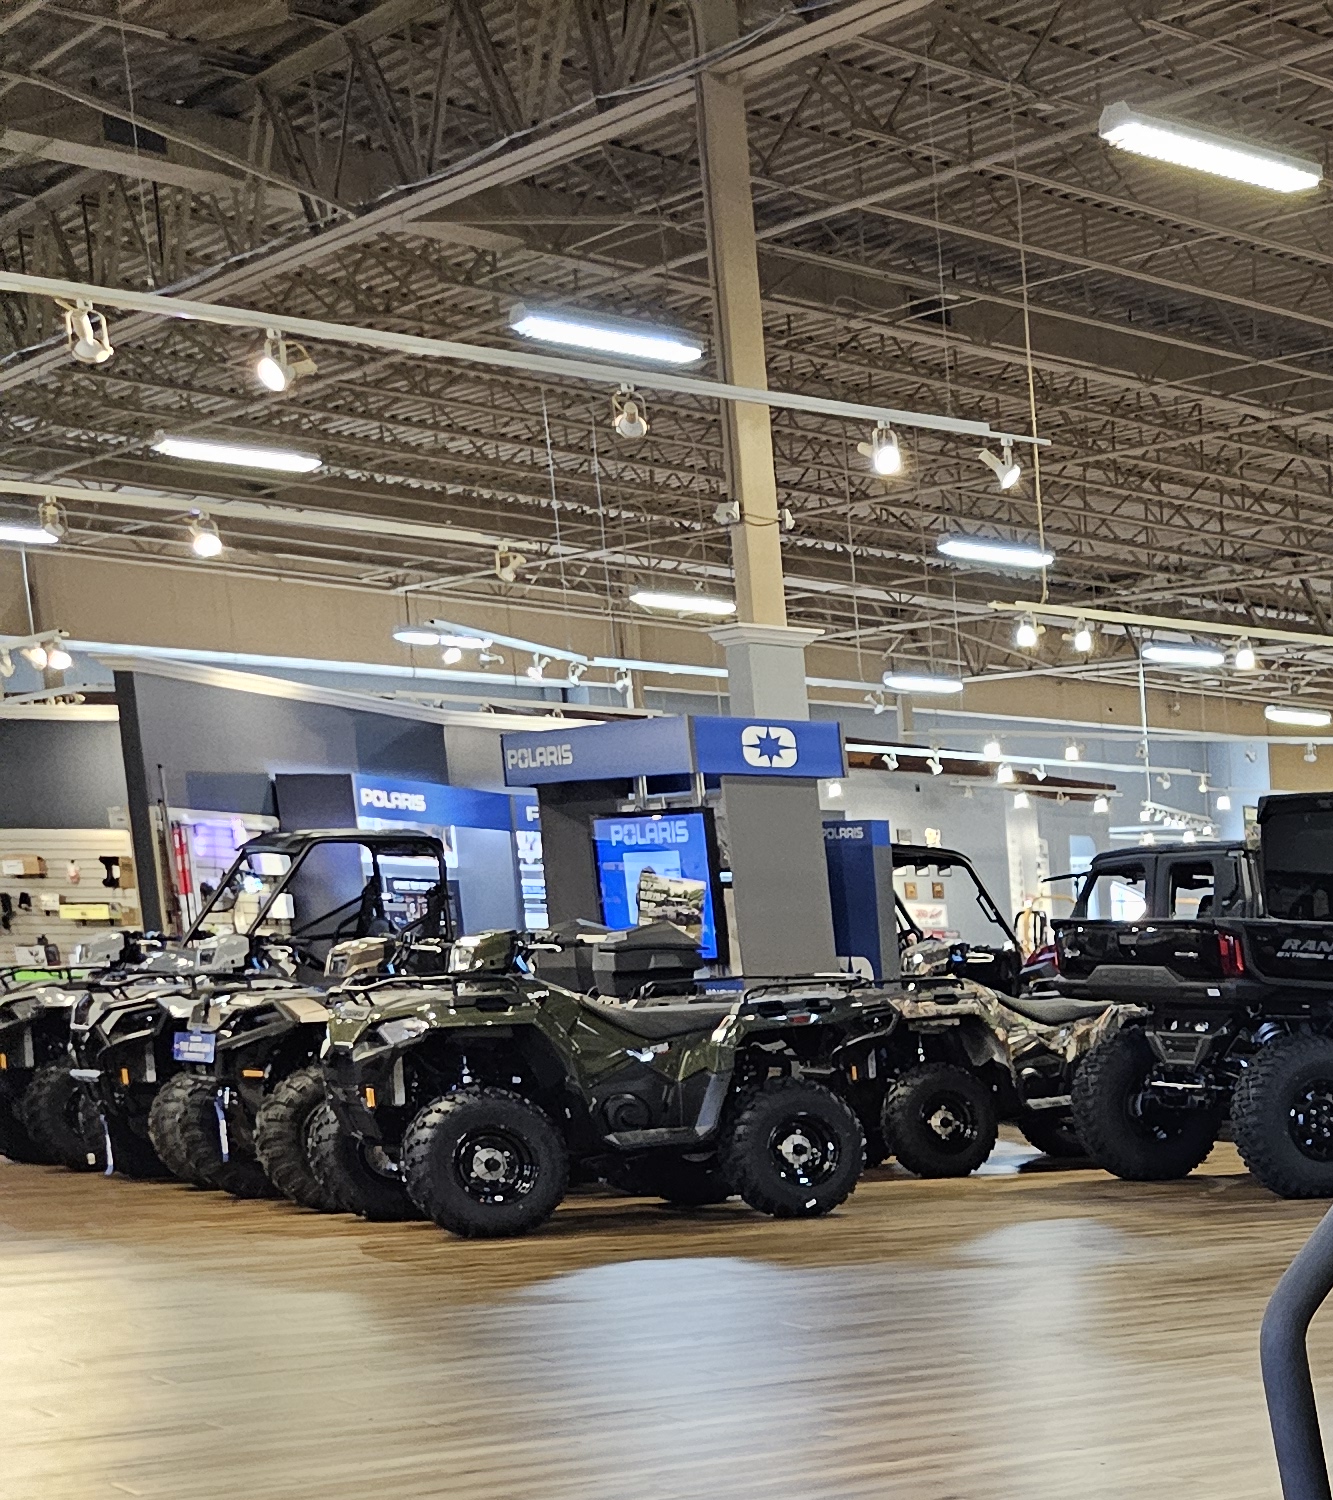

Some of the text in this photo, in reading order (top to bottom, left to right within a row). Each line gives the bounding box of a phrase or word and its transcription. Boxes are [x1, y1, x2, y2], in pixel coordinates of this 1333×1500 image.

[507, 744, 573, 769] POLARIS
[360, 787, 427, 812] POLARIS
[610, 820, 690, 846] POLARIS
